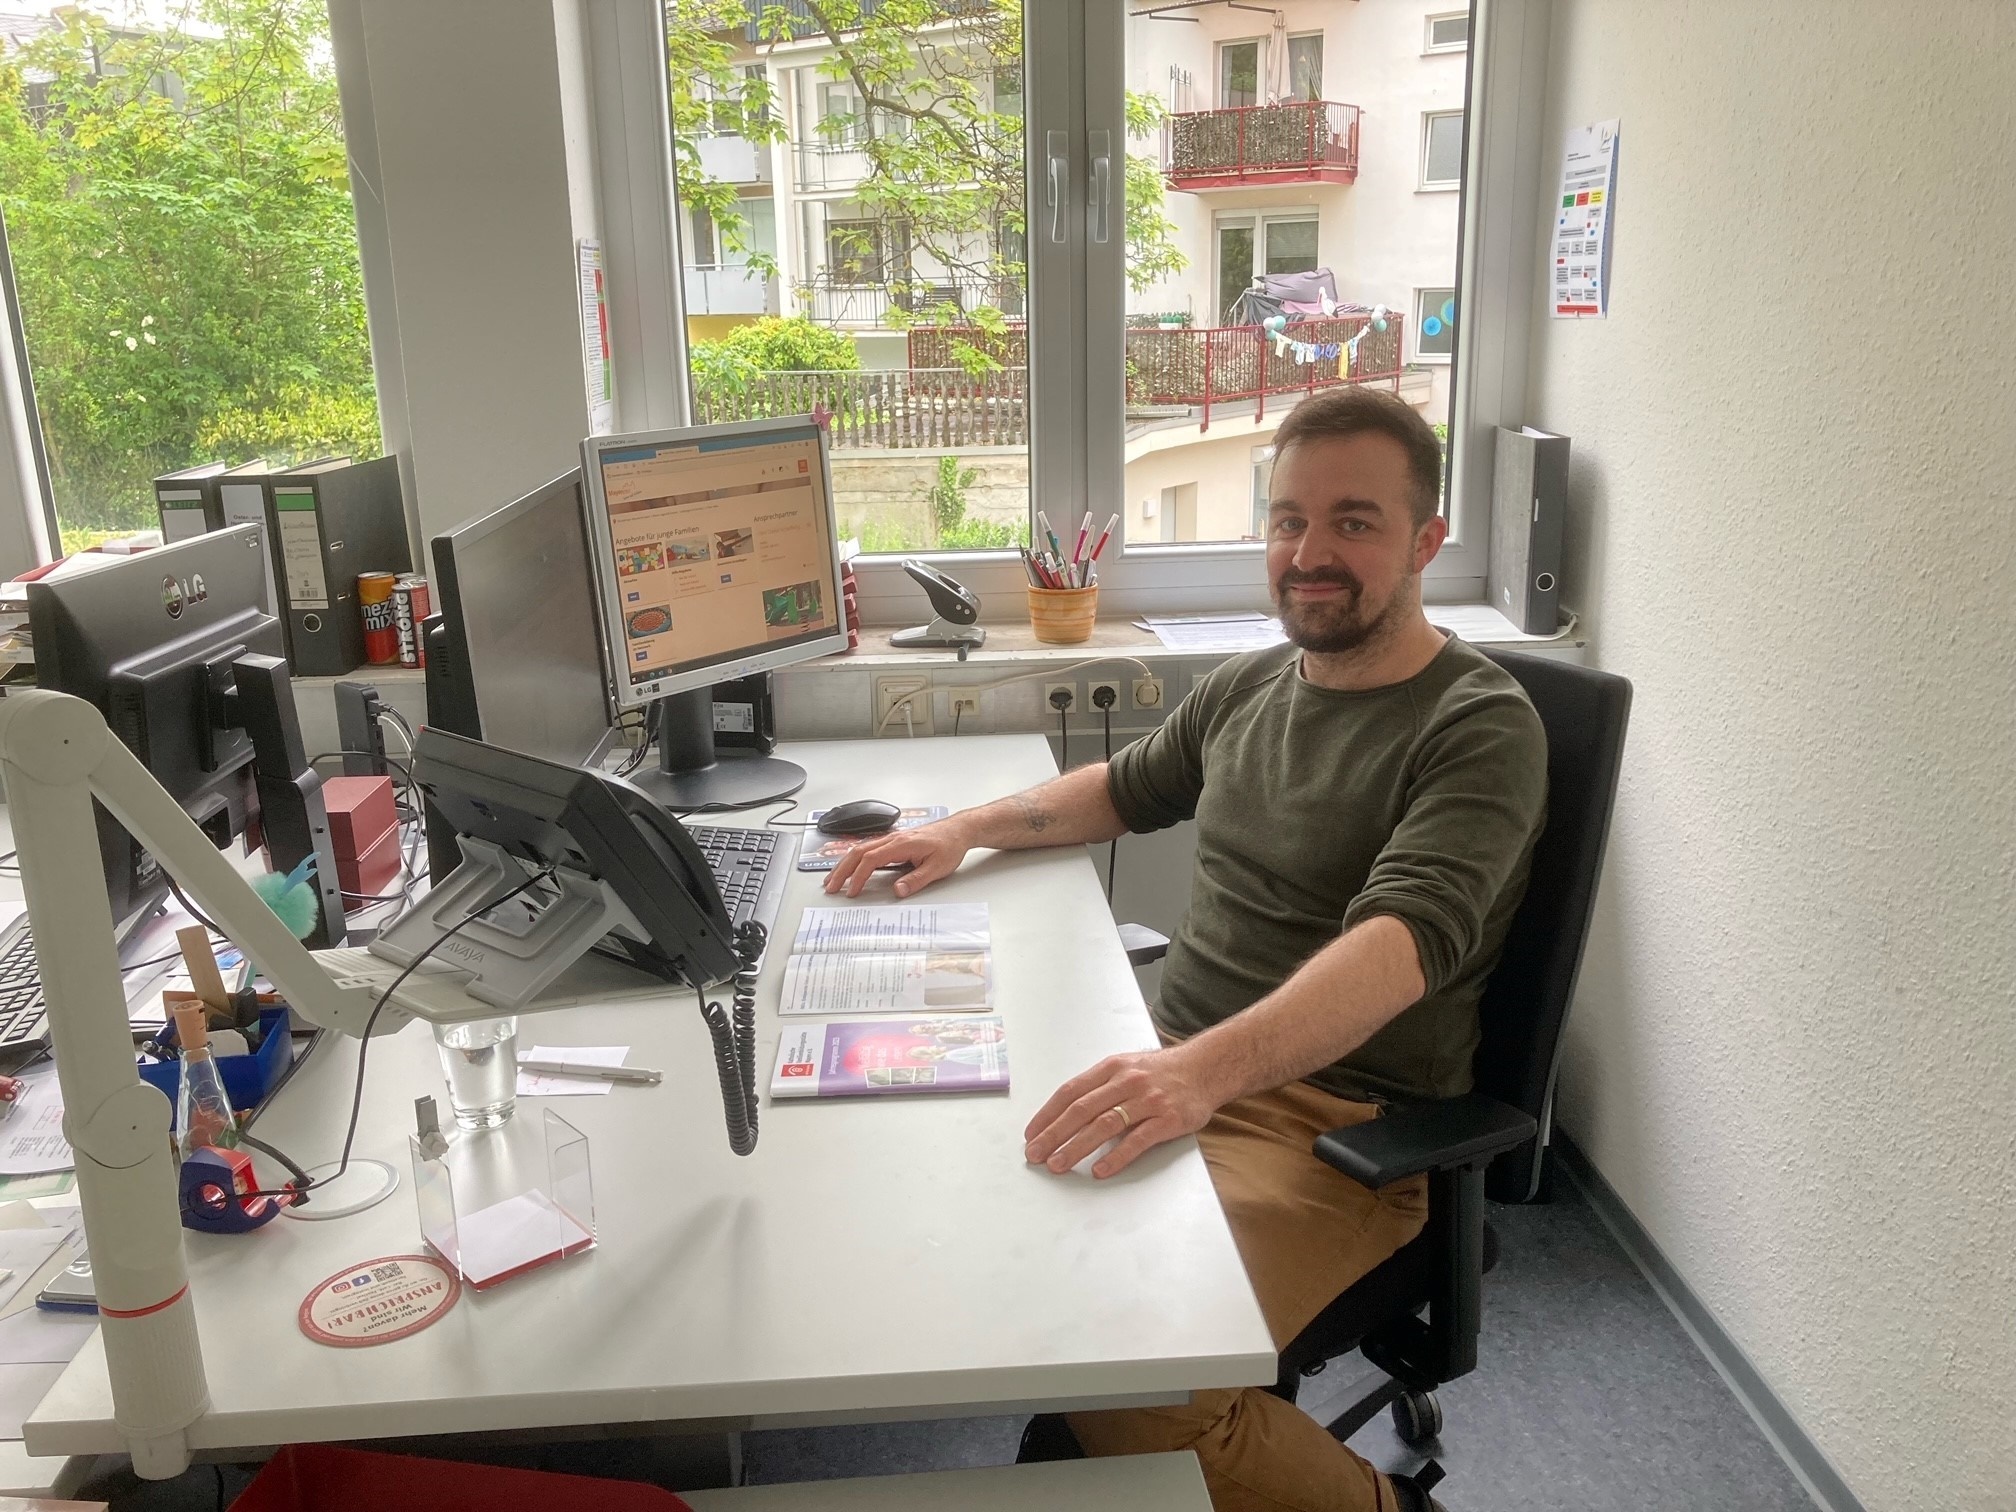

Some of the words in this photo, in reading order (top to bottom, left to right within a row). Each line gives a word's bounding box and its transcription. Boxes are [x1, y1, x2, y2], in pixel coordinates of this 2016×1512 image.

[753, 510, 798, 523] Ansprechpartner
[615, 535, 645, 546] Angebote
[646, 532, 656, 541] für
[656, 530, 673, 541] junge
[674, 526, 700, 535] Familien
[183, 573, 208, 606] LG
[361, 595, 392, 618] mez
[396, 592, 417, 663] STRONG
[804, 860, 838, 868] ayen
[443, 942, 486, 963] AVAYA
[370, 1310, 392, 1322] sind
[394, 1303, 413, 1314] Wir
[401, 1304, 428, 1317] Mehr
[362, 1315, 399, 1333] davon?
